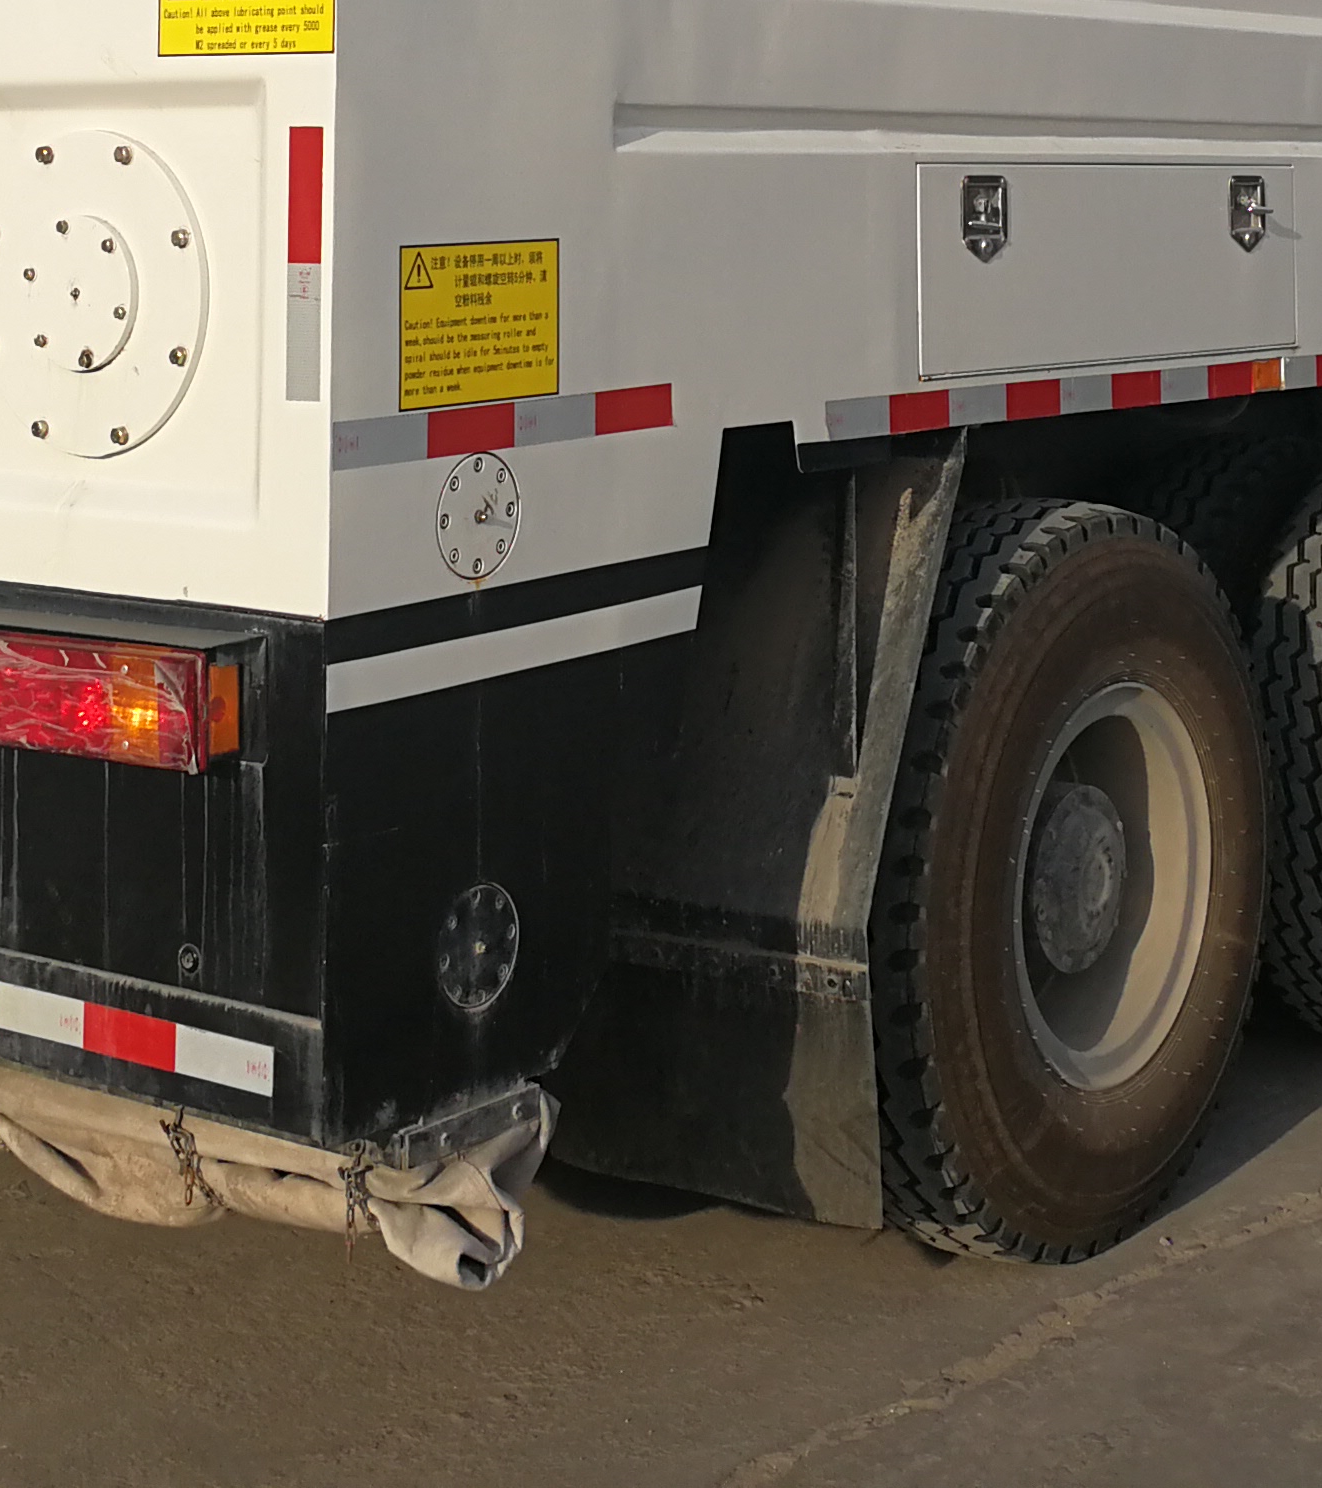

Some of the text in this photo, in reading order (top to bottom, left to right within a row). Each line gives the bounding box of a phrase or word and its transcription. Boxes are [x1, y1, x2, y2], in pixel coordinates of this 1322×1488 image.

[234, 5, 274, 18] lubricating
[277, 5, 297, 16] point
[300, 3, 324, 15] should
[207, 22, 233, 36] applied
[254, 23, 278, 35] grease
[281, 23, 300, 33] every
[500, 313, 509, 323] for
[529, 312, 542, 321] than
[447, 334, 454, 343] be
[458, 333, 467, 343] the
[504, 328, 523, 338] roller
[526, 326, 536, 336] and
[430, 350, 450, 361] should
[453, 350, 460, 359] be
[480, 346, 490, 356] for
[405, 369, 425, 381] powder
[430, 366, 454, 377] residue
